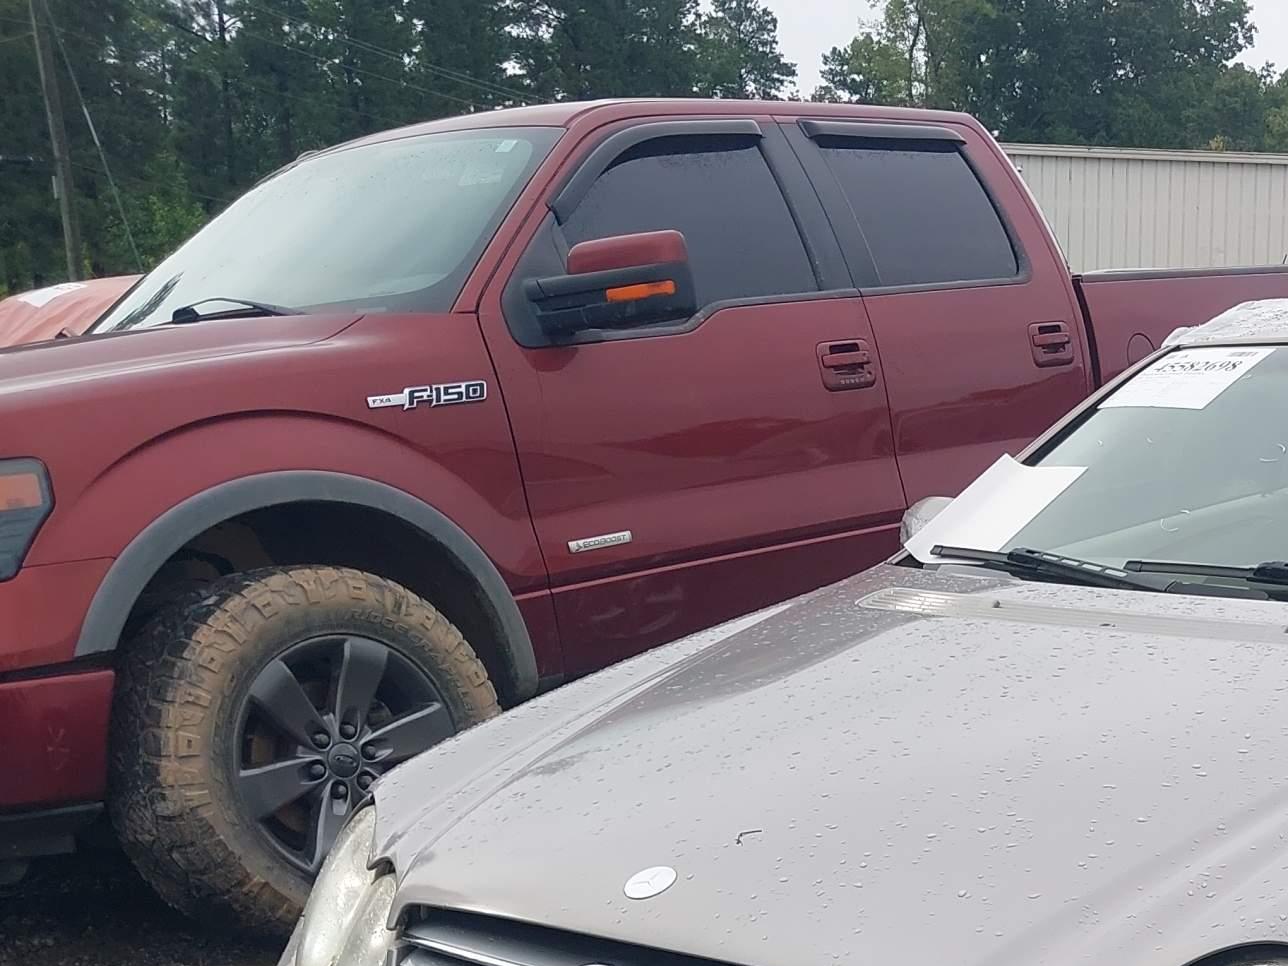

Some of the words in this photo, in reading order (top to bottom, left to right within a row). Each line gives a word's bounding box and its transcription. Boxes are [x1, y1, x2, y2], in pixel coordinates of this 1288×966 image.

[371, 397, 392, 405] FX4
[406, 381, 486, 408] F-150
[582, 534, 627, 549] ECOBOOST
